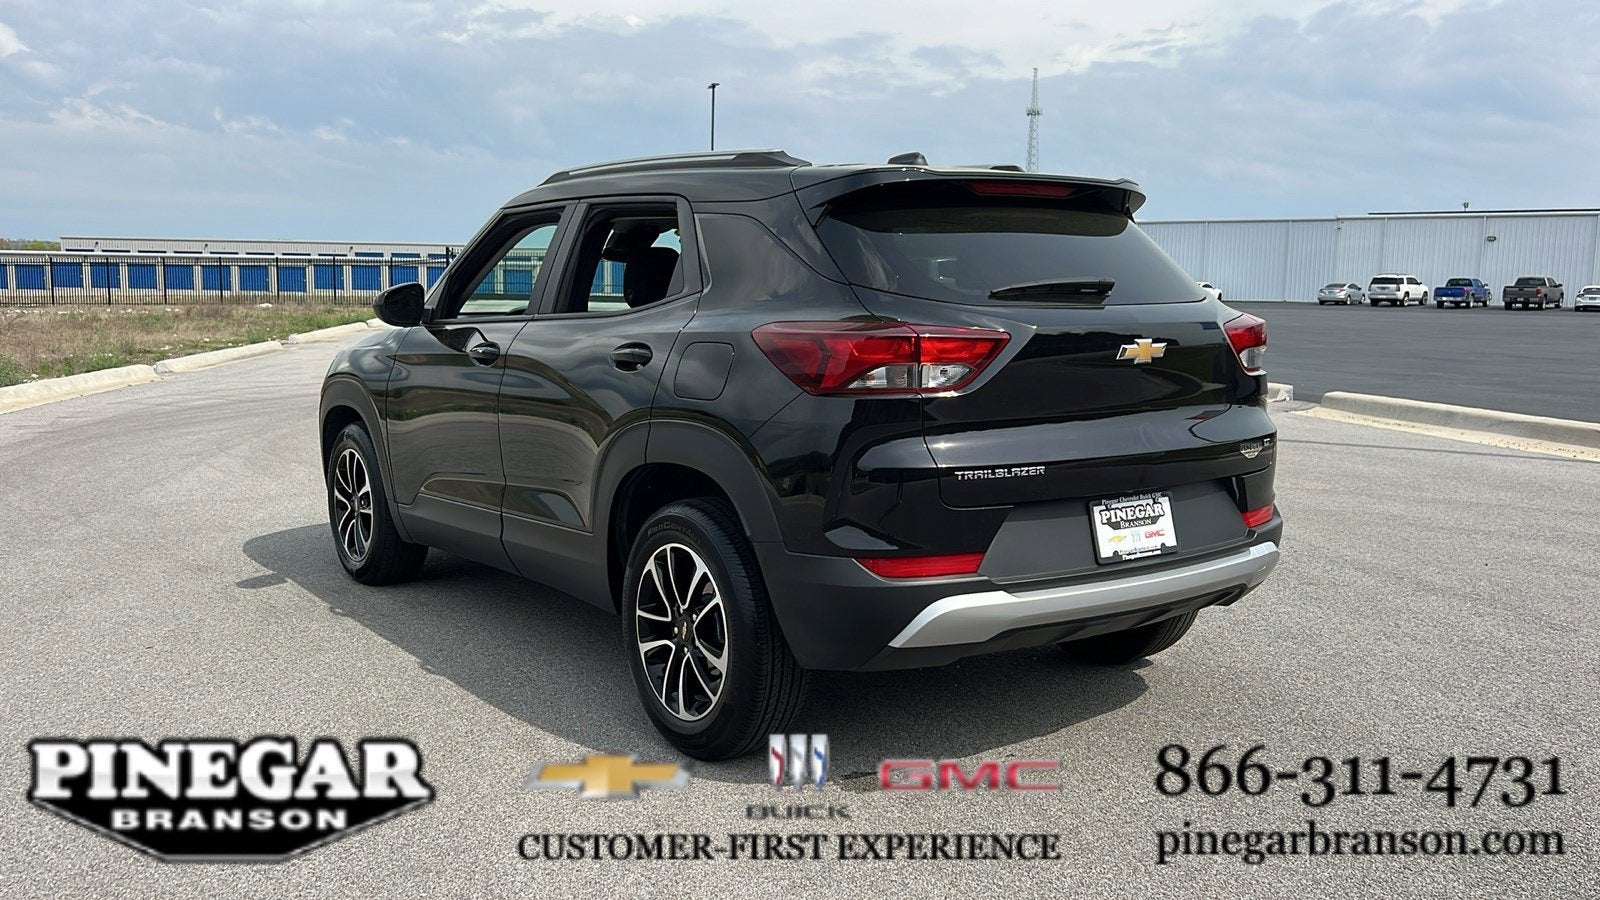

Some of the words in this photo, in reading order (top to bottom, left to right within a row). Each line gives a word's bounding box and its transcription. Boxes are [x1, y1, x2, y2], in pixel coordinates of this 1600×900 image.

[954, 465, 1046, 480] TRAILBLAZER
[1101, 503, 1164, 524] PINEGAR
[1144, 530, 1165, 539] GMC
